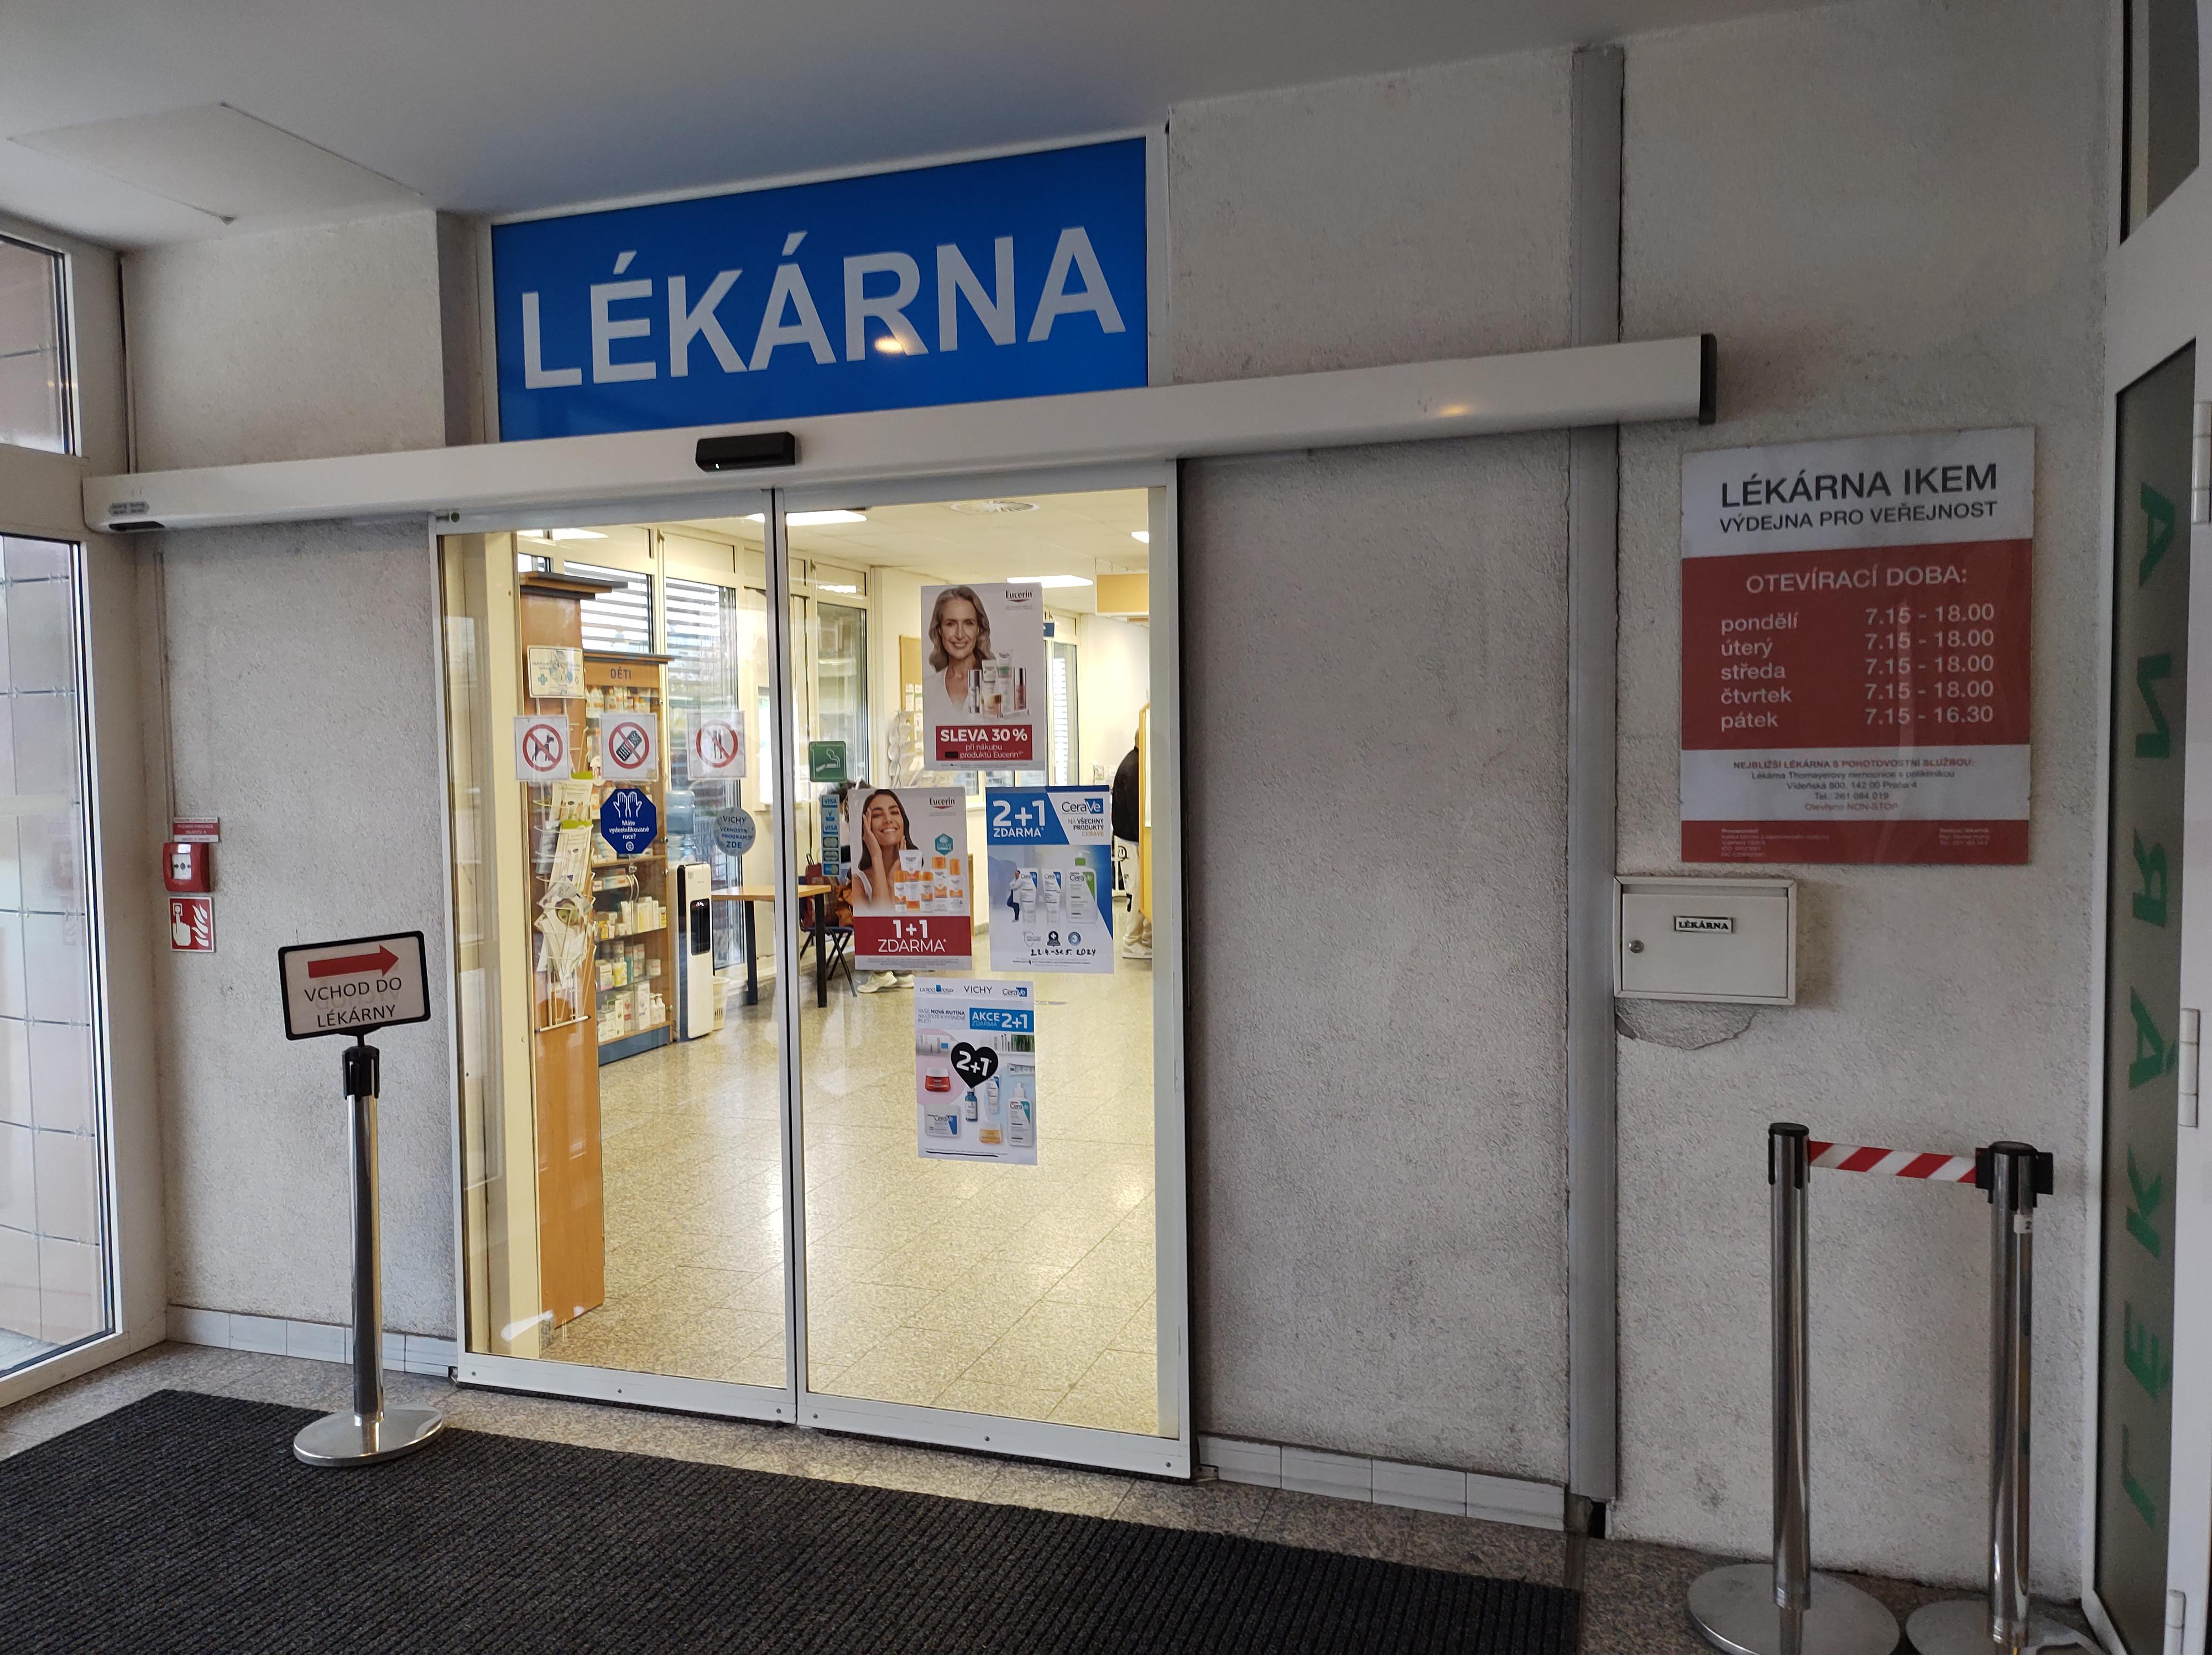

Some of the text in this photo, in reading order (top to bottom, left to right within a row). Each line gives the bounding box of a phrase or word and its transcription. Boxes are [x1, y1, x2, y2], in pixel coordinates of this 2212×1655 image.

[522, 226, 1126, 390] LÉKÁRNA
[1721, 462, 1997, 508] LÉKÁRNA IKEM
[1720, 500, 1998, 533] VÝDEJNA PRO VEŘEJNOST
[1746, 565, 1967, 594] OTEVÍRACÍ DOBA:
[1720, 612, 1799, 636] pondělí
[1865, 608, 1911, 625] 7.15
[1936, 603, 1994, 622] 18.00
[1720, 637, 1773, 659] úterý
[1865, 633, 1911, 650] 7.15
[1936, 629, 1994, 648] 18.00
[610, 667, 632, 680] DĚTI
[1720, 661, 1786, 681] středa
[1865, 658, 1911, 675] 7.15
[1935, 654, 1994, 672] 18.00
[1720, 686, 1792, 704] čtvrtek
[1865, 683, 1911, 701] 7.15
[1934, 680, 1994, 698] 18.00
[1720, 710, 1778, 732] pátek
[1865, 708, 1911, 725] 7.15
[1935, 704, 1994, 724] 16.30
[940, 729, 989, 743] SLEVA
[959, 751, 992, 759] produktů
[976, 743, 1003, 751] nákupu
[1783, 759, 1830, 769] LÉKÁRNA
[1841, 758, 1921, 768] POHOTOVOSTNÍ
[993, 800, 1046, 827] 2+1
[1061, 800, 1101, 813] CeraVe
[722, 815, 747, 825] VICHY
[1077, 817, 1104, 825] VŠECHNY
[726, 840, 742, 849] ZDE
[893, 919, 928, 938] 1+1
[1678, 919, 1730, 930] LÉKÁRNA
[304, 981, 370, 1003] VCHOD
[377, 977, 403, 993] DO
[963, 985, 993, 994] VICHY
[317, 1004, 397, 1028] LÉKÁRNY
[972, 1011, 1000, 1022] AKCE
[1001, 1013, 1028, 1029] 2+1
